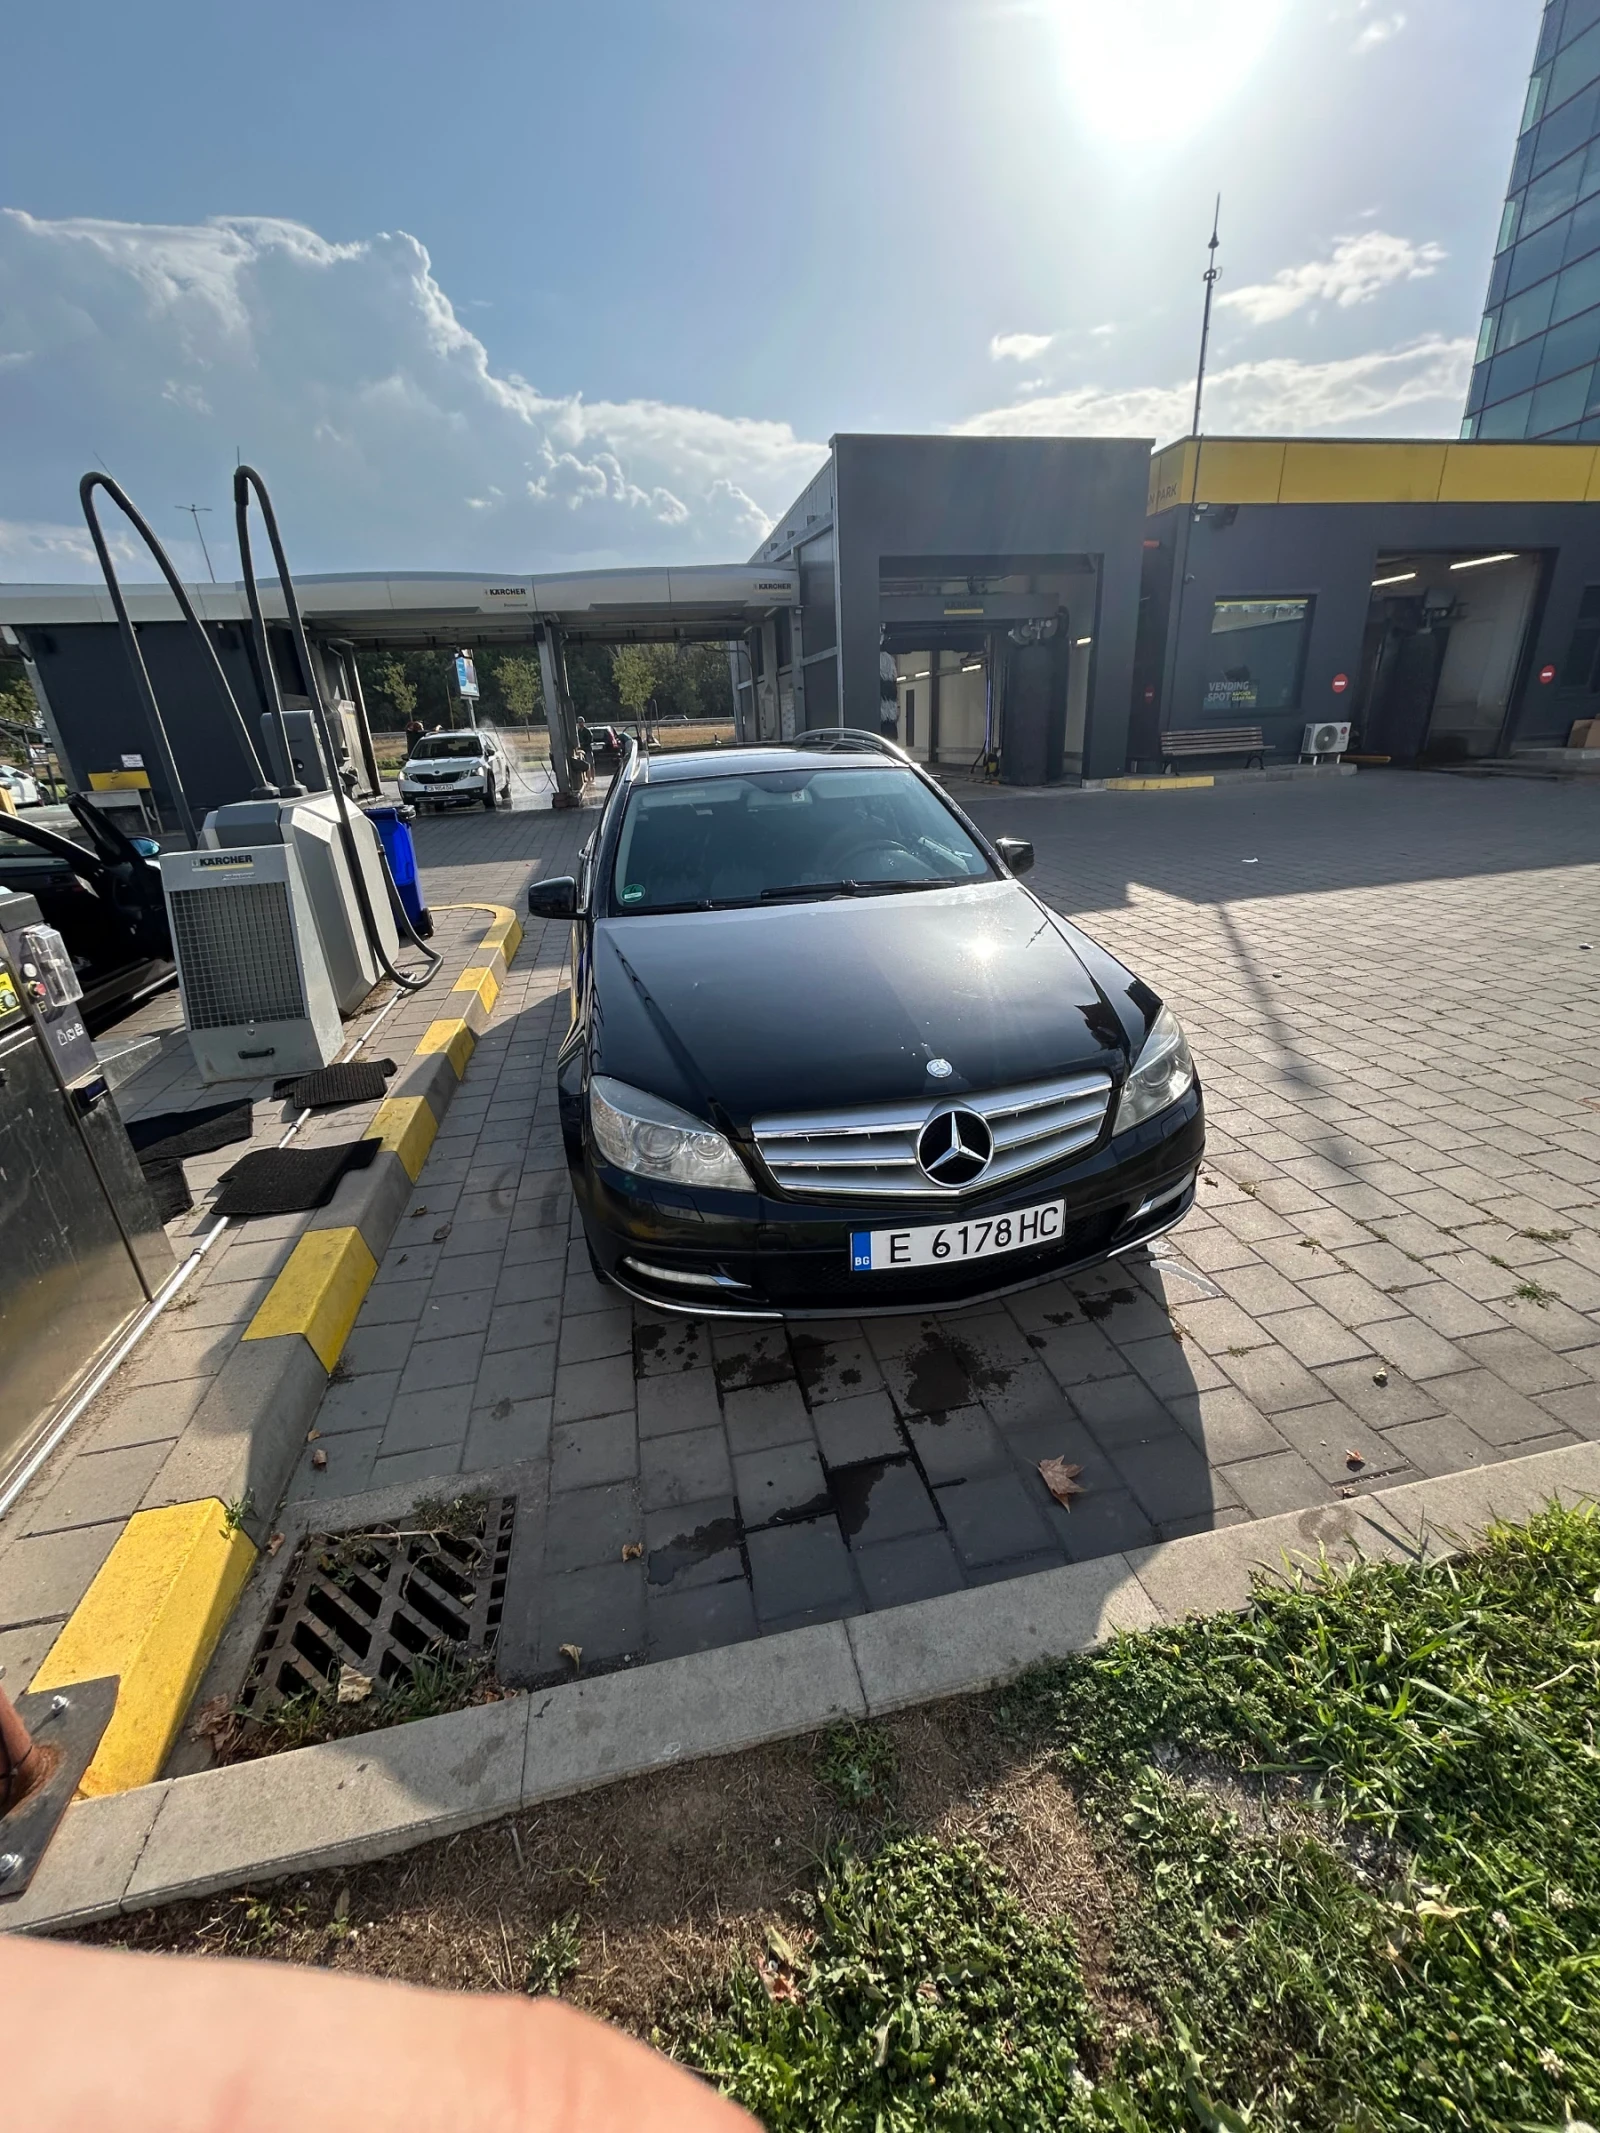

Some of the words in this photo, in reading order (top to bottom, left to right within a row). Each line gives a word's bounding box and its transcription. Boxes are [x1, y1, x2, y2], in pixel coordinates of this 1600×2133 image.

[1209, 681, 1249, 691] VENDING
[1207, 692, 1231, 702] SPOT
[890, 1233, 911, 1264] E
[855, 1256, 870, 1266] BG
